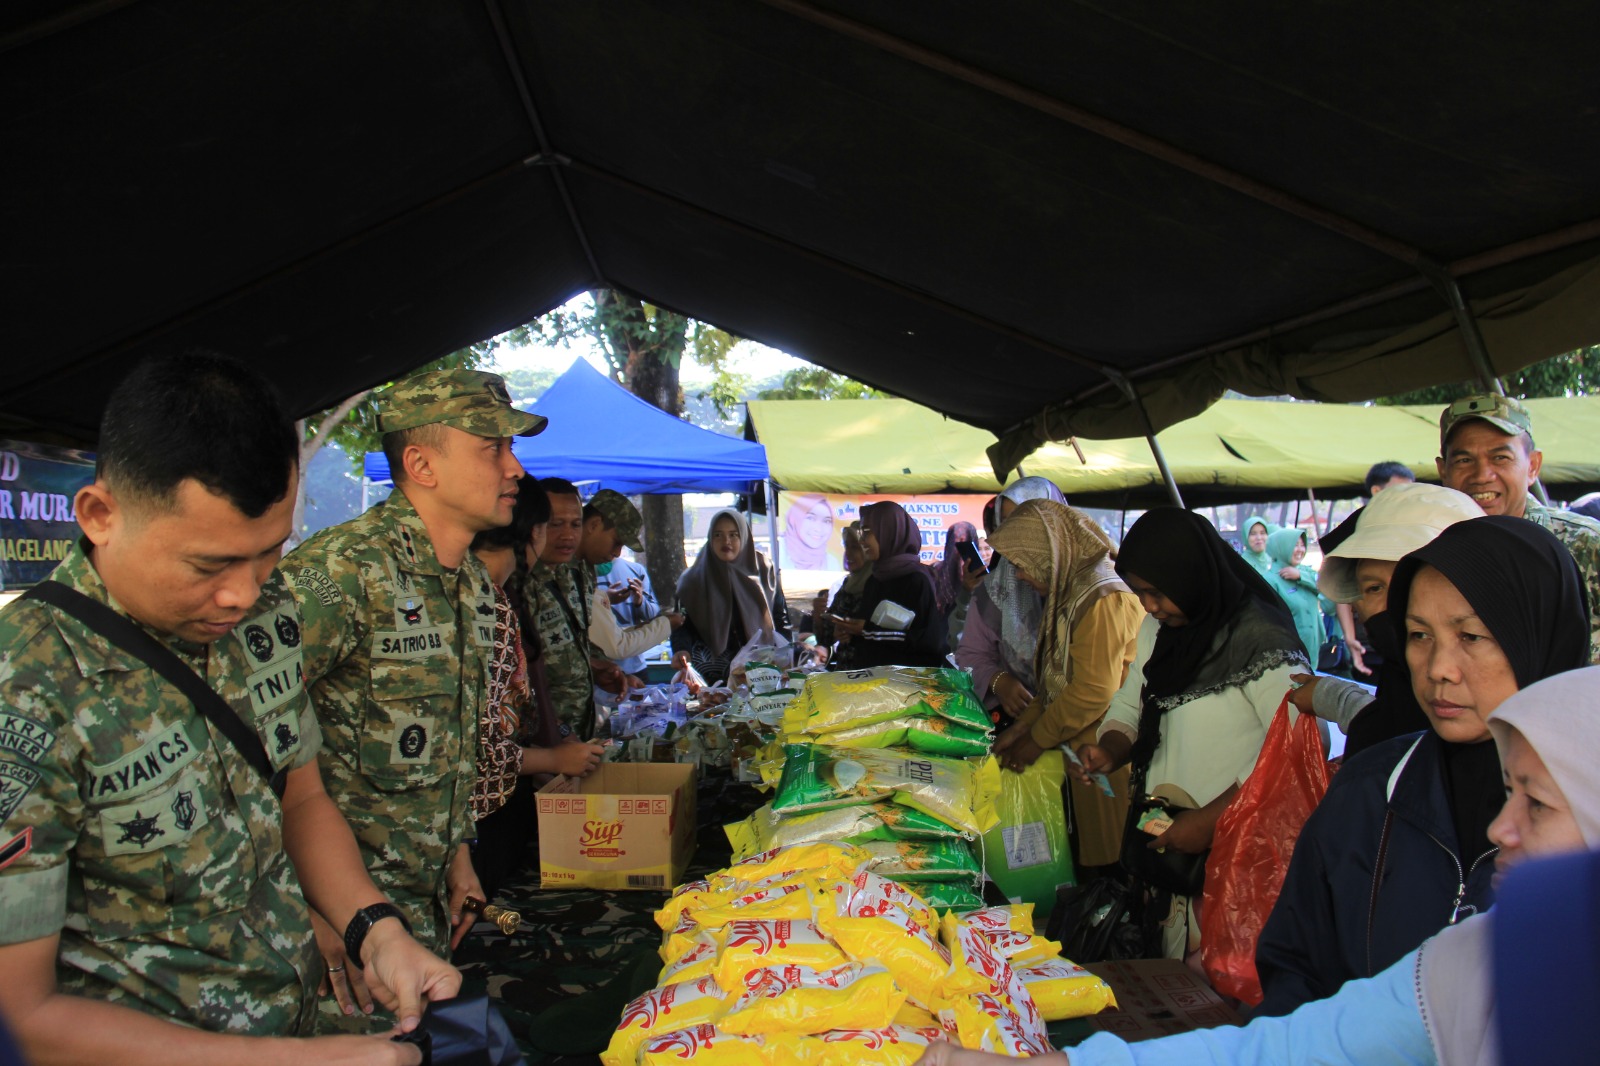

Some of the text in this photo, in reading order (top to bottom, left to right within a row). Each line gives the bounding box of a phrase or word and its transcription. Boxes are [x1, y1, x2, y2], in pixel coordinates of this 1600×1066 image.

[302, 568, 340, 599] RAIDER
[381, 632, 442, 654] SATRIO B.B
[253, 669, 291, 704] TNI
[159, 732, 189, 764] C.S
